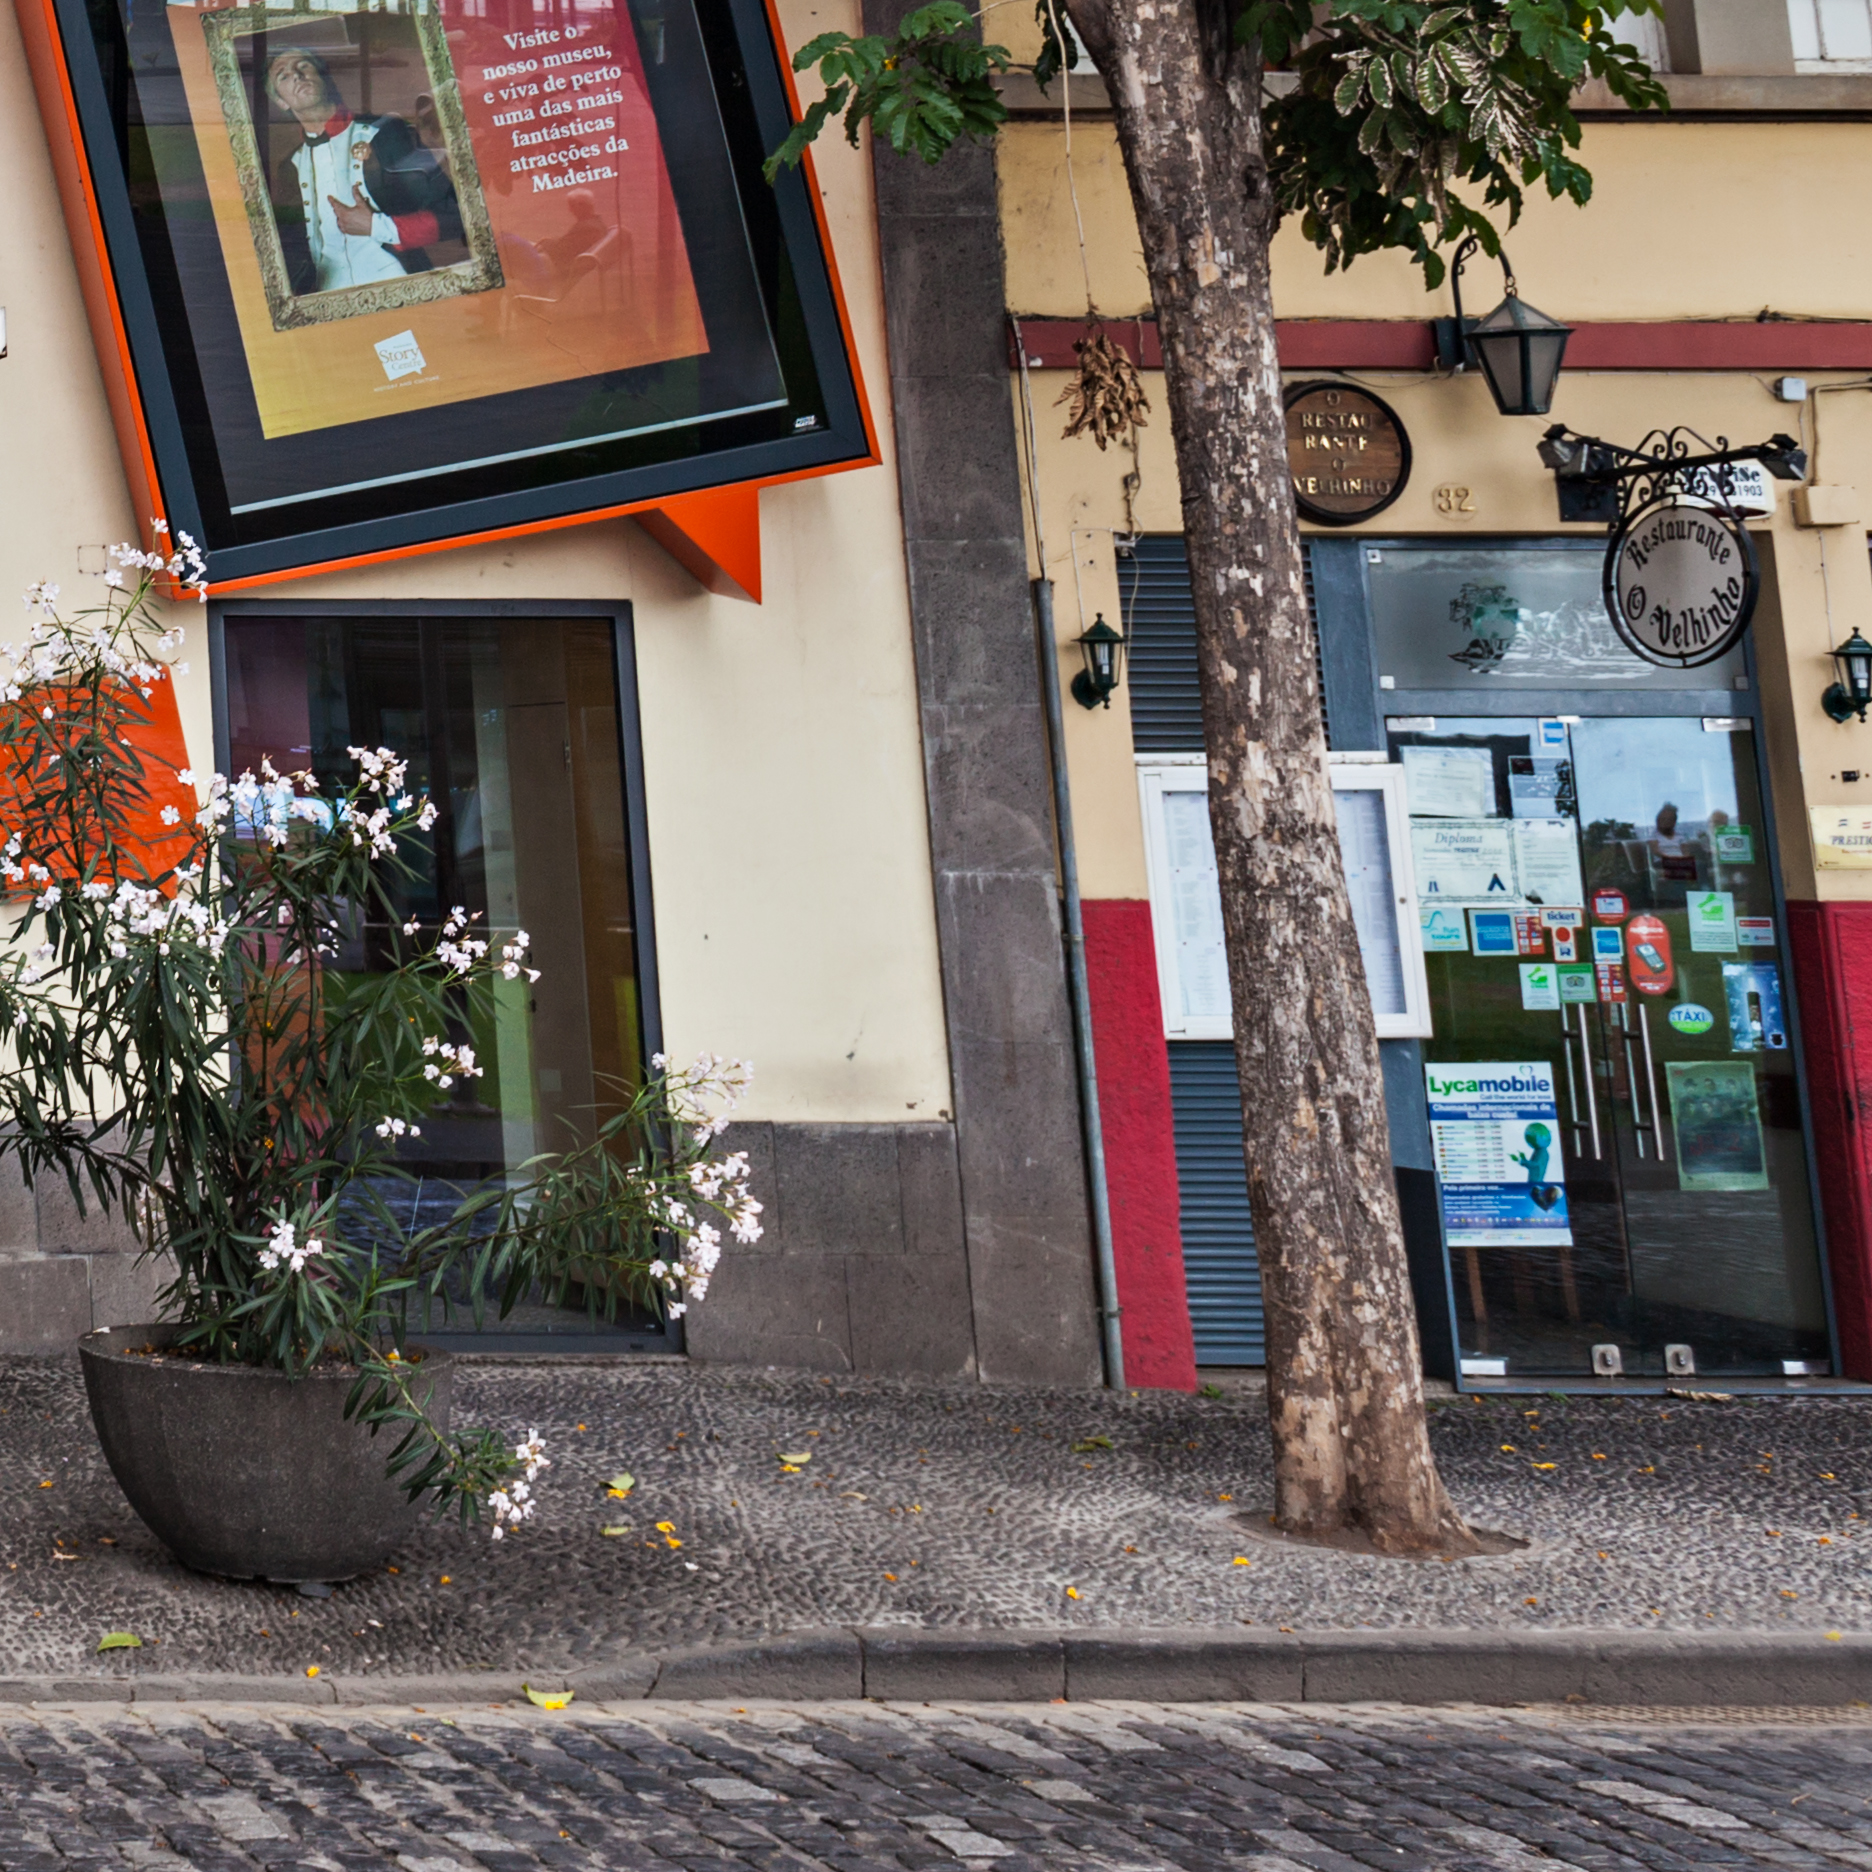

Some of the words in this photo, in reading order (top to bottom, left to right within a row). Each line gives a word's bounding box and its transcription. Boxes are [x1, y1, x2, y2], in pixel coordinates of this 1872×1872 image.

[503, 28, 561, 51] Visite
[565, 26, 577, 39] o
[482, 58, 538, 81] nosso
[542, 44, 612, 68] museu,
[483, 91, 495, 104] e
[499, 82, 540, 101] viva
[543, 74, 567, 93] de
[571, 65, 622, 91] perto
[492, 108, 536, 127] uma
[539, 99, 573, 118] das
[576, 87, 624, 110] mais
[511, 116, 616, 148] fantásticas
[509, 143, 601, 173] atracções
[604, 135, 630, 154] da
[532, 164, 619, 193] Madeira.
[378, 347, 420, 365] Story
[1327, 391, 1341, 406] O
[1301, 413, 1373, 429] RESTAU
[1305, 434, 1369, 451] RANTE
[1293, 476, 1391, 496] VELHINHO
[1437, 486, 1476, 514] 32
[1625, 517, 1731, 572] Restaurante
[1649, 575, 1741, 649] Velhinho
[1547, 911, 1575, 921] ticket
[1429, 1076, 1550, 1096] Lycamobile
